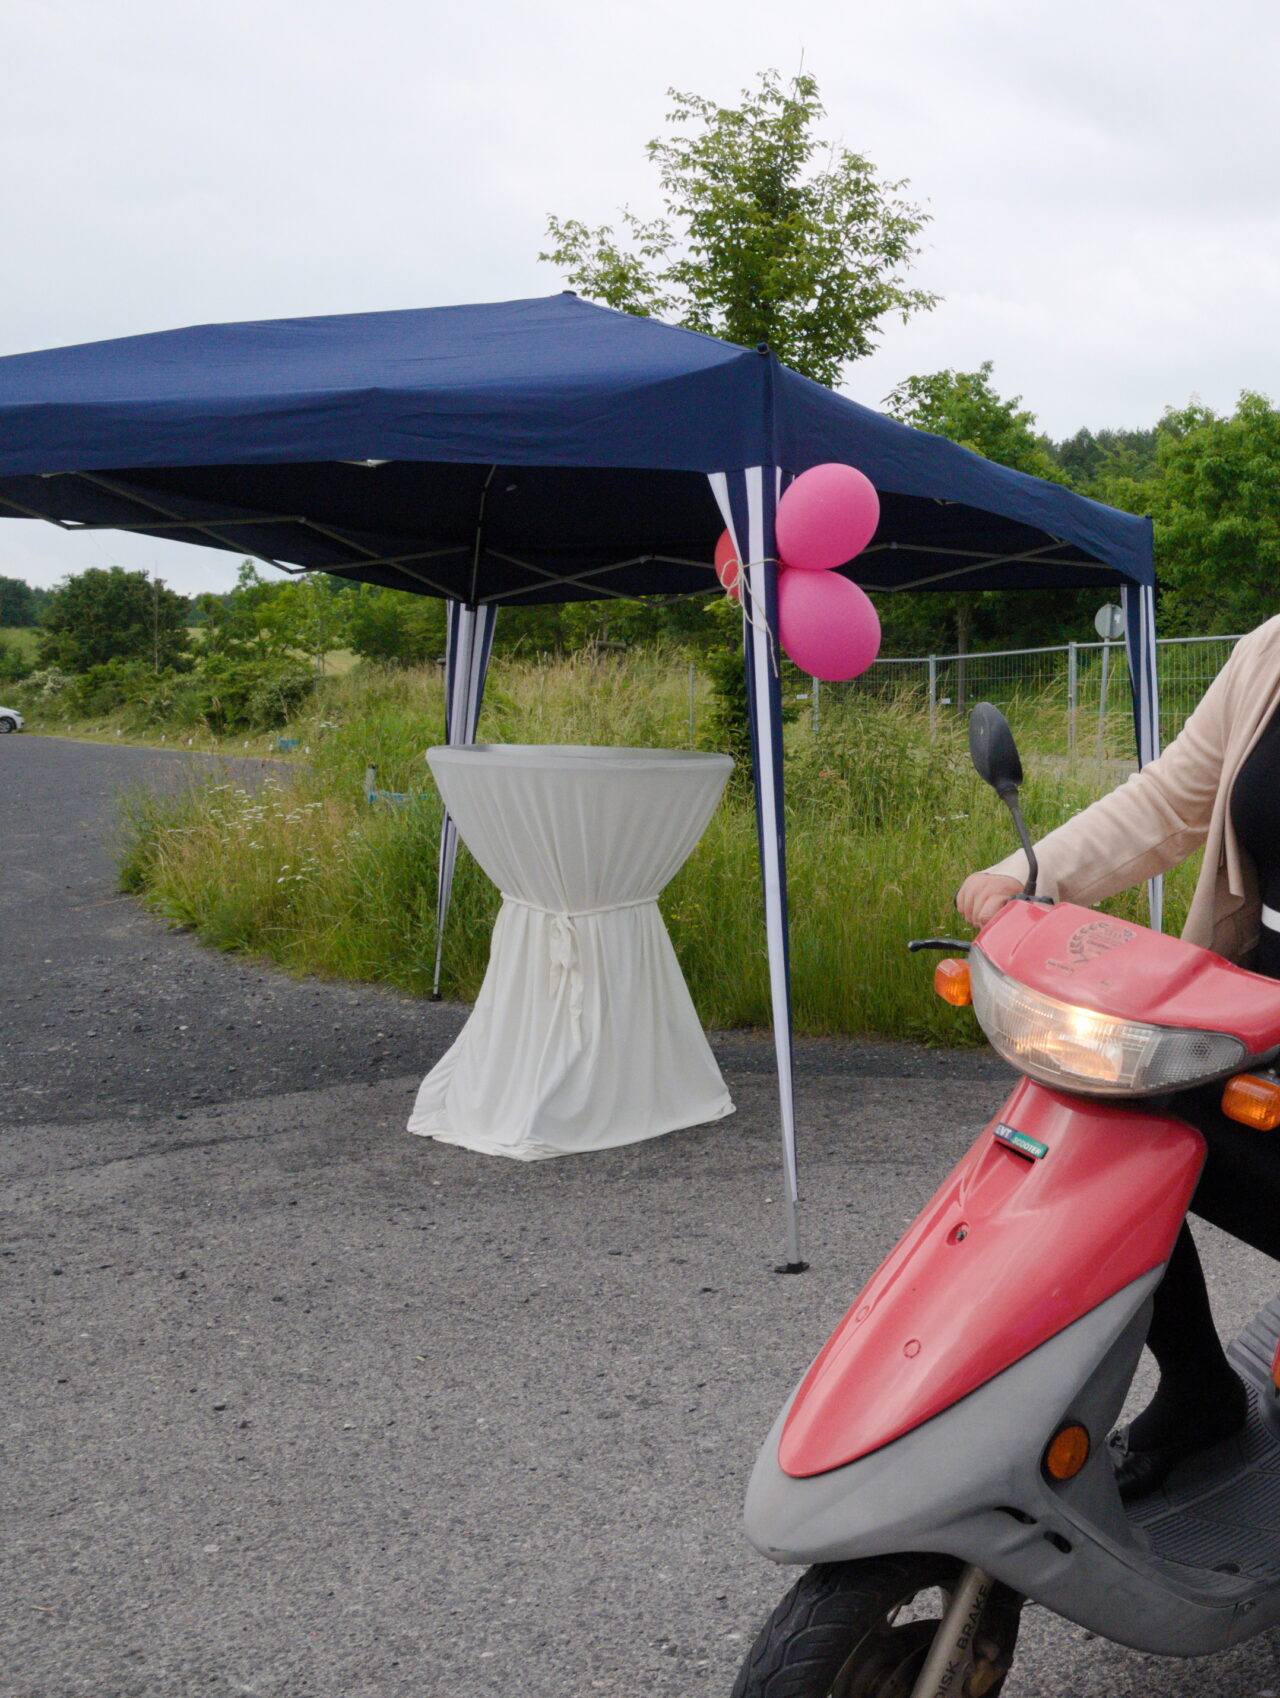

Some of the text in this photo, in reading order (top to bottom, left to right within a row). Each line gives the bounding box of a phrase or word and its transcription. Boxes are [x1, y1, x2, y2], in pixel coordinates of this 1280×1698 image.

[995, 1123, 1043, 1155] EVT SCOOTER
[956, 1584, 988, 1650] BRAKE
